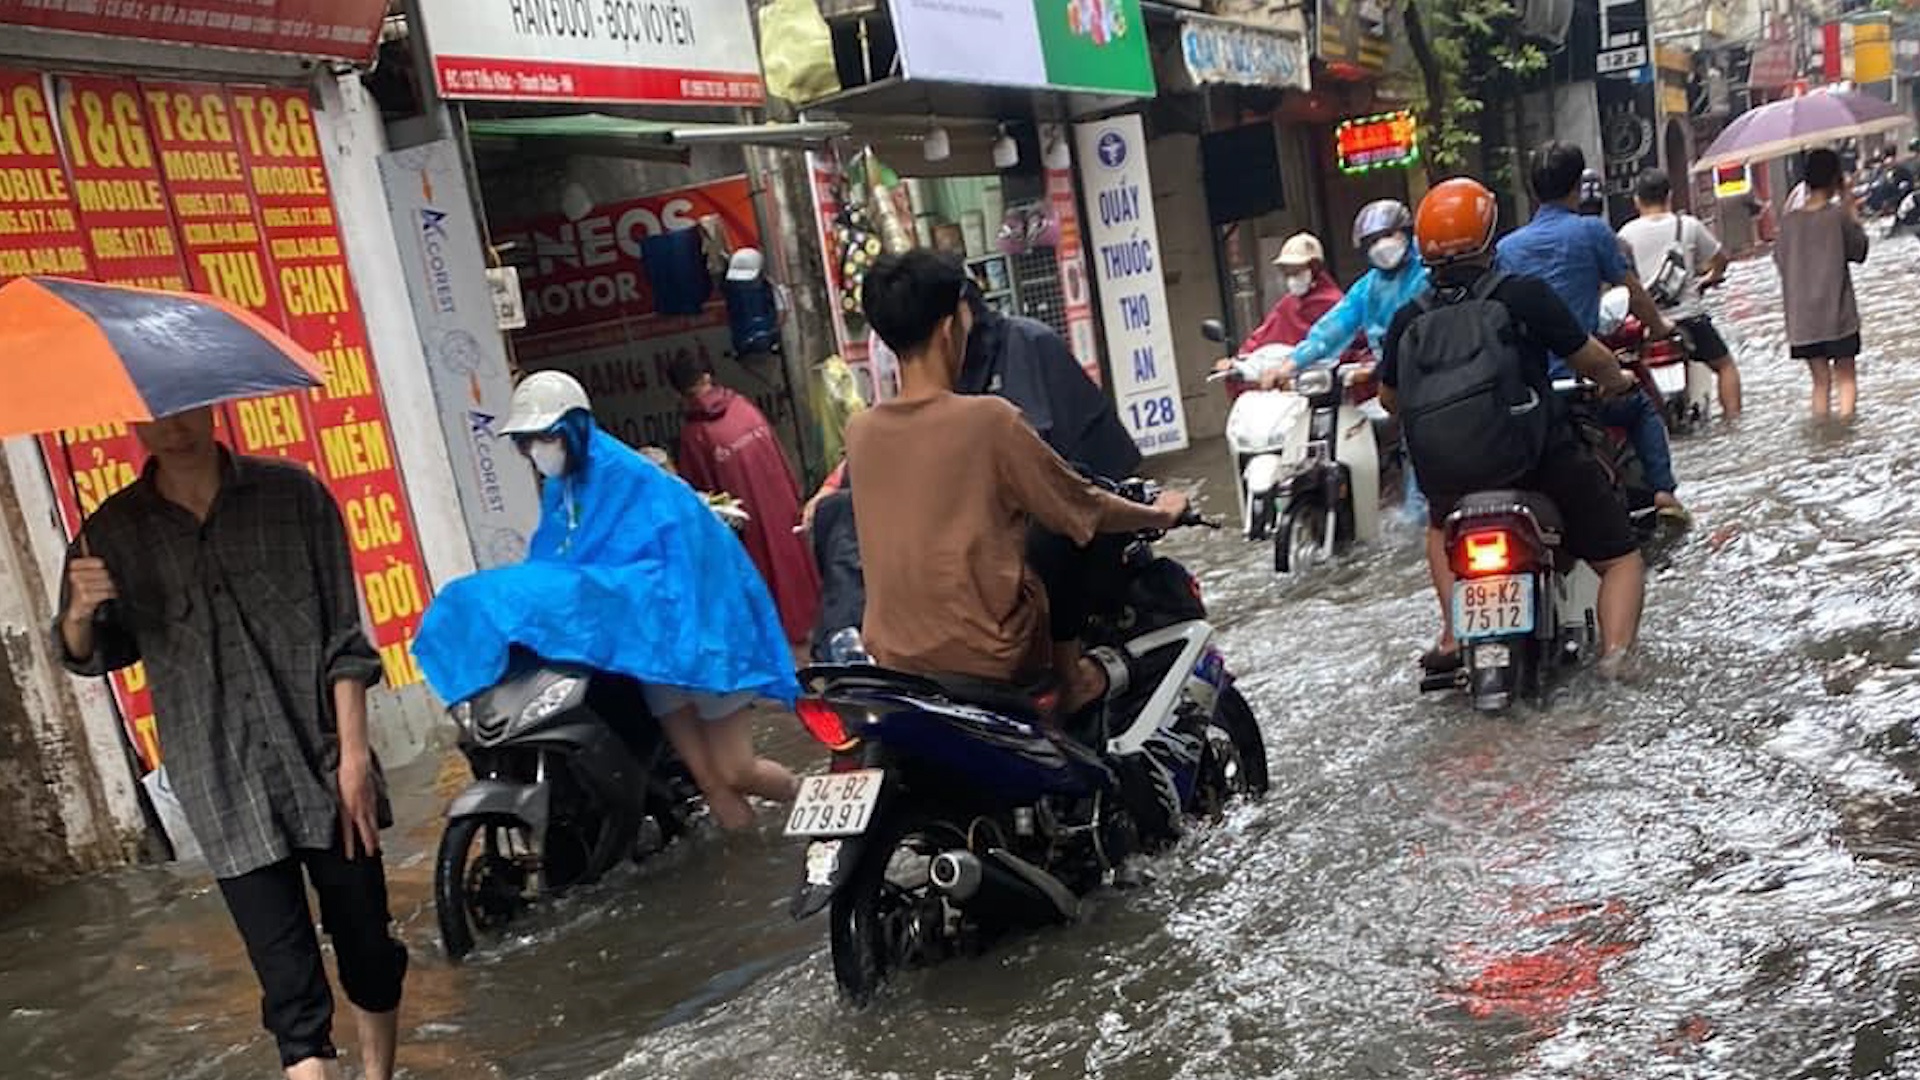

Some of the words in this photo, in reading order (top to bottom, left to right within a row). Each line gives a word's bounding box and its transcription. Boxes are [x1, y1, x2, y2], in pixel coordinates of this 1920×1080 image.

[1604, 52, 1638, 67] 122
[144, 90, 232, 142] T&G
[234, 96, 318, 157] T&G
[162, 150, 244, 181] MOBILE
[251, 166, 327, 195] MOBILE
[75, 179, 166, 211] MOBILE
[1101, 227, 1153, 280] THUỐC
[198, 251, 268, 309] THU
[1119, 293, 1151, 335] THỌ
[1133, 345, 1157, 383] AN
[1127, 396, 1175, 431] 128
[345, 484, 403, 552] CÁC
[364, 554, 424, 626] ĐỜI
[1465, 582, 1521, 607] 89-K2
[1465, 605, 1521, 632] 7512
[807, 775, 869, 802] 34-B2
[790, 803, 867, 831] 079.91
